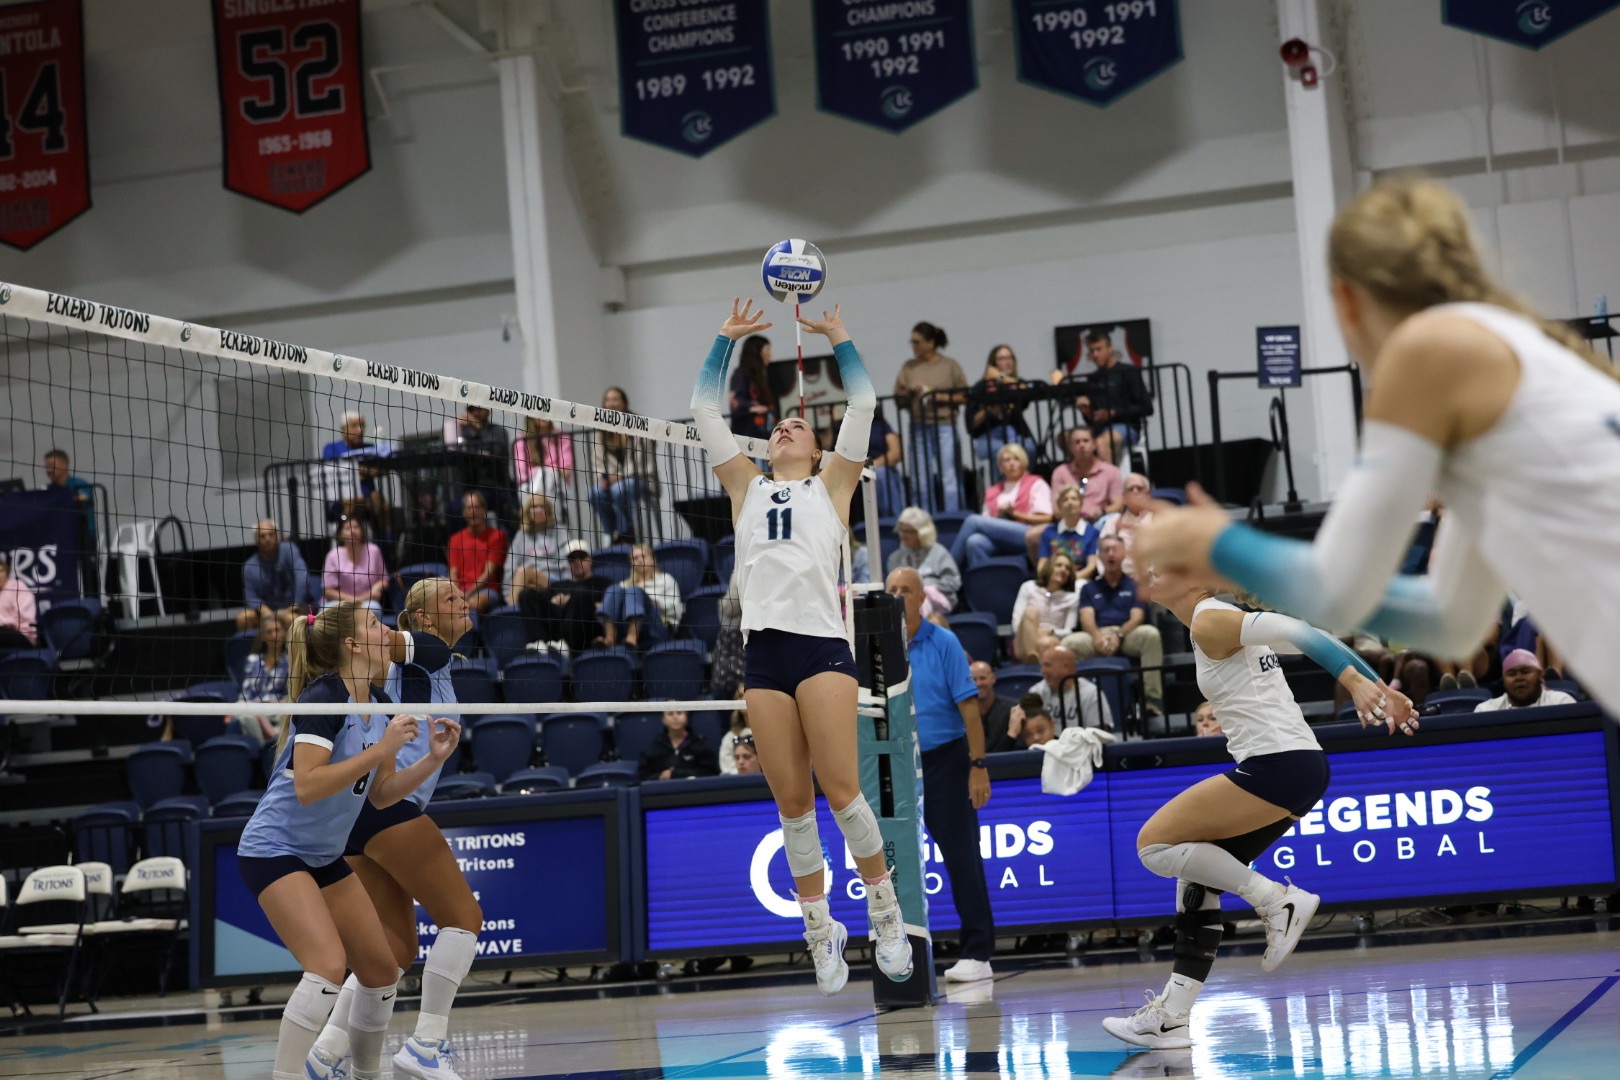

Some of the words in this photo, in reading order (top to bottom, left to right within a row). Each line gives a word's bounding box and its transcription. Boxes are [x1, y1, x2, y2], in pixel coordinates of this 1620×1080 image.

[224, 0, 347, 19] SINGLE
[643, 4, 738, 33] CONFERENCE
[846, 1, 936, 26] CHAMPIONS
[1032, 8, 1088, 32] 1990
[1104, 0, 1157, 23] 1991
[648, 26, 736, 53] CHAMPIONS
[841, 37, 890, 61] 1990
[897, 30, 945, 53] 1991
[1070, 25, 1125, 50] 1992
[236, 18, 345, 125] 52
[870, 55, 919, 79] 1992
[635, 73, 688, 101] 1989
[701, 64, 756, 91] 1992
[0, 59, 68, 161] 4
[775, 280, 812, 291] molten
[46, 293, 95, 322] ECKERD
[99, 305, 151, 334] TRITONS
[220, 330, 261, 355] ECKERD
[262, 339, 309, 364] TRITONS
[367, 360, 399, 384] ECKERD
[402, 368, 440, 391] TRITONS
[489, 386, 519, 408] ECKERD
[520, 394, 551, 413] TRITONS
[594, 407, 621, 426] ECKERD
[622, 414, 649, 432] TRITONS
[685, 425, 701, 441] ECK
[766, 507, 792, 540] 11
[0, 543, 58, 587] RS
[874, 653, 886, 697] STER
[1258, 653, 1281, 673] ECK
[1282, 786, 1494, 837] EGENDS
[455, 832, 526, 851] TRITONS
[1273, 831, 1495, 869] GLOBAL
[136, 868, 175, 881] TRITONS
[456, 857, 515, 872] Tritons
[32, 878, 74, 892] TRITONS
[846, 864, 1055, 900] GOAL
